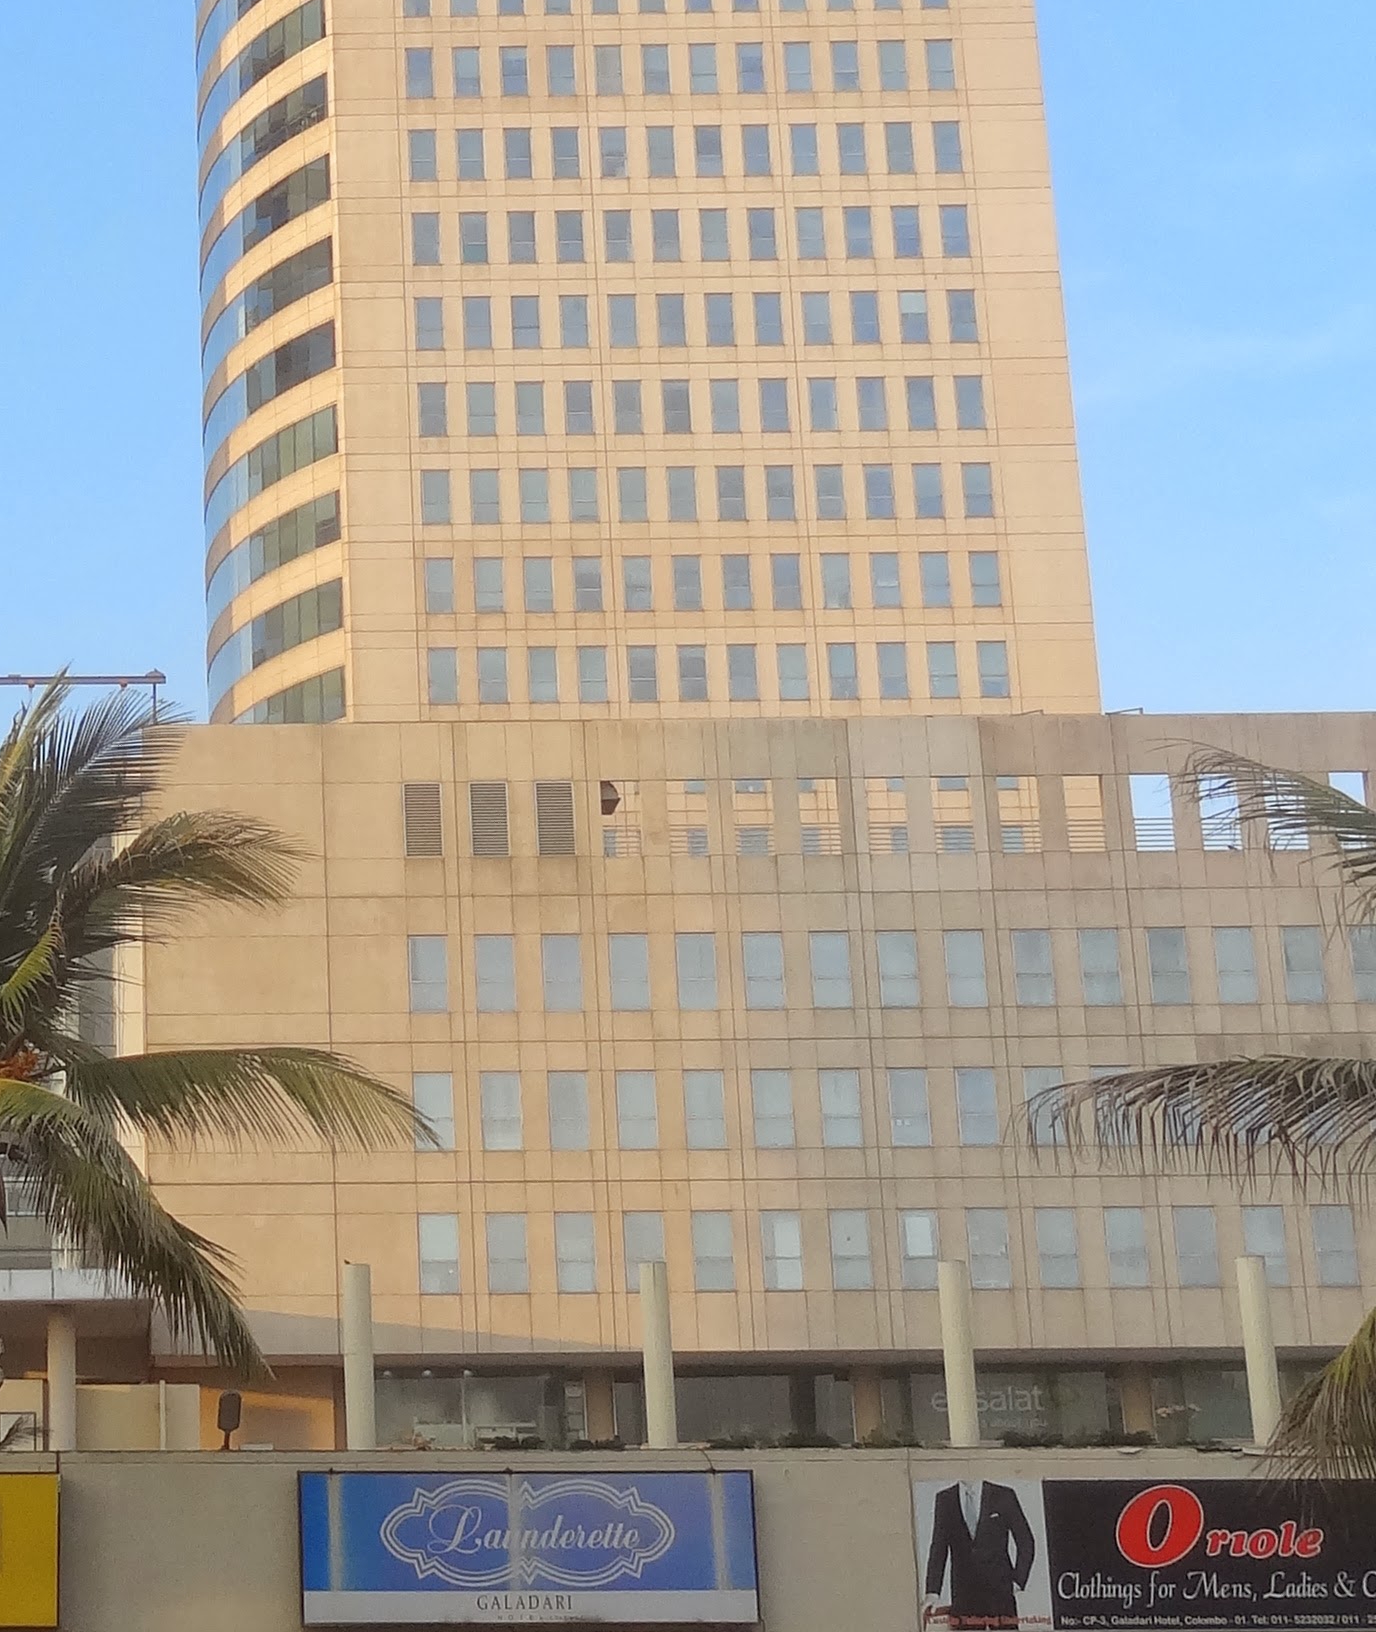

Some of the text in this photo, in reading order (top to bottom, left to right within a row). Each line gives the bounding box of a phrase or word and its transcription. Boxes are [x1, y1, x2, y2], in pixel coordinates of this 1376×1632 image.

[427, 1504, 642, 1554] Launderette
[1116, 1484, 1324, 1568] Oriole
[476, 1594, 573, 1611] GALADARI
[1057, 1571, 1142, 1609] Clothings
[1147, 1571, 1176, 1608] for
[1182, 1571, 1258, 1602] Mens,
[1263, 1571, 1327, 1599] Ladies
[1333, 1571, 1356, 1598] &
[1184, 1615, 1227, 1625] Colombo
